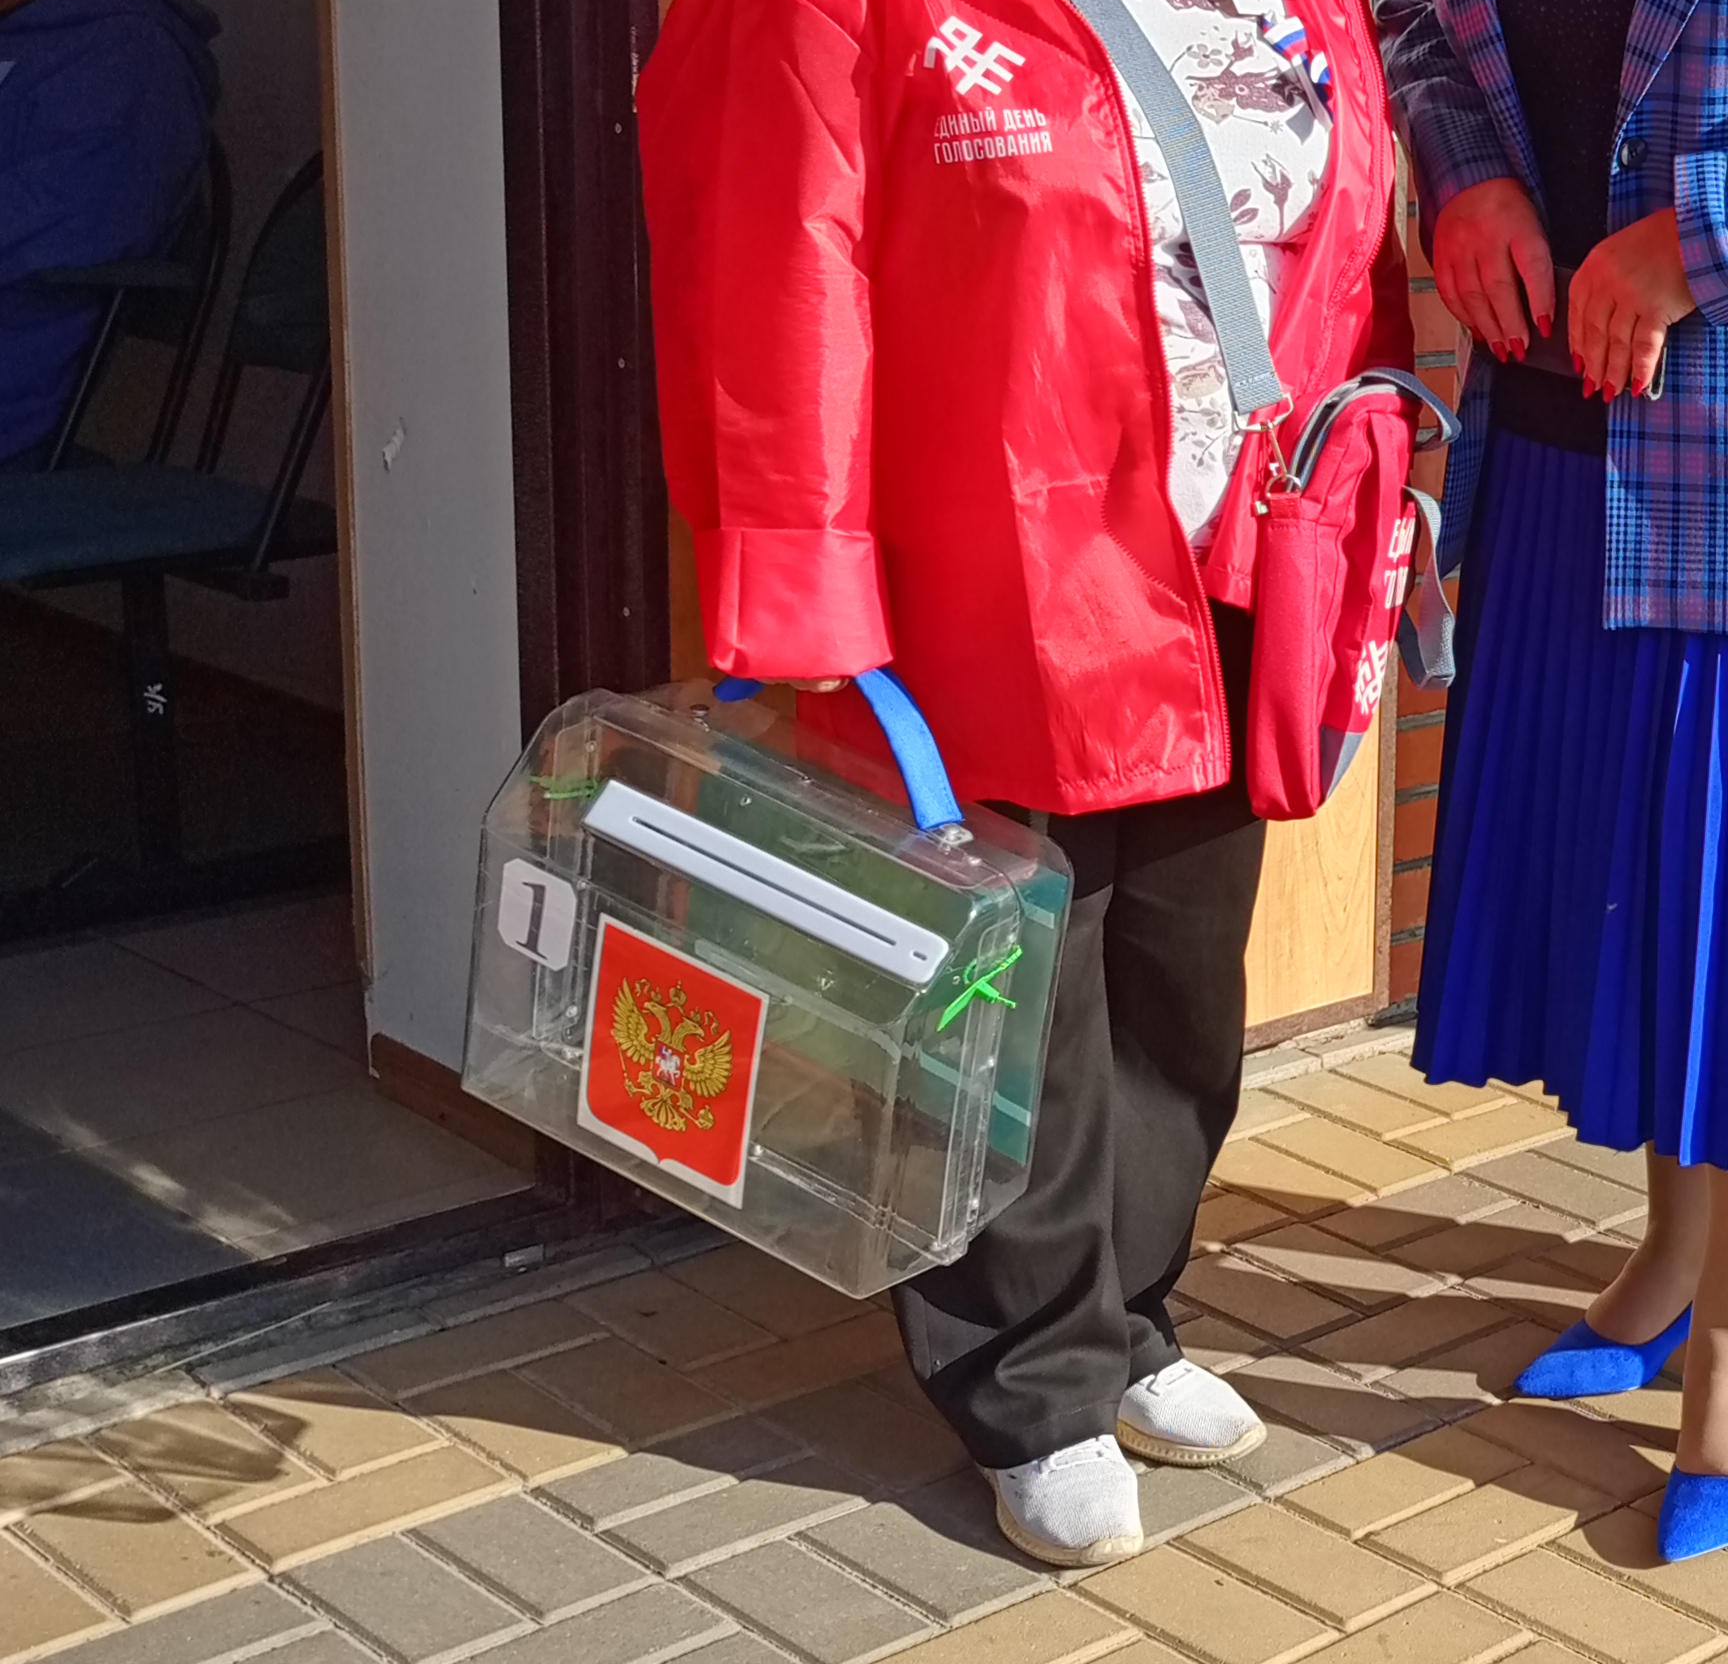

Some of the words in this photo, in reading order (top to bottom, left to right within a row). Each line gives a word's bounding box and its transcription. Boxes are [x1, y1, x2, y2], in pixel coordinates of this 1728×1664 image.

[1003, 108, 1047, 131] ДЕНЬ
[934, 131, 1053, 164] ГОЛОСОВАНИЯ
[515, 881, 549, 963] 1
